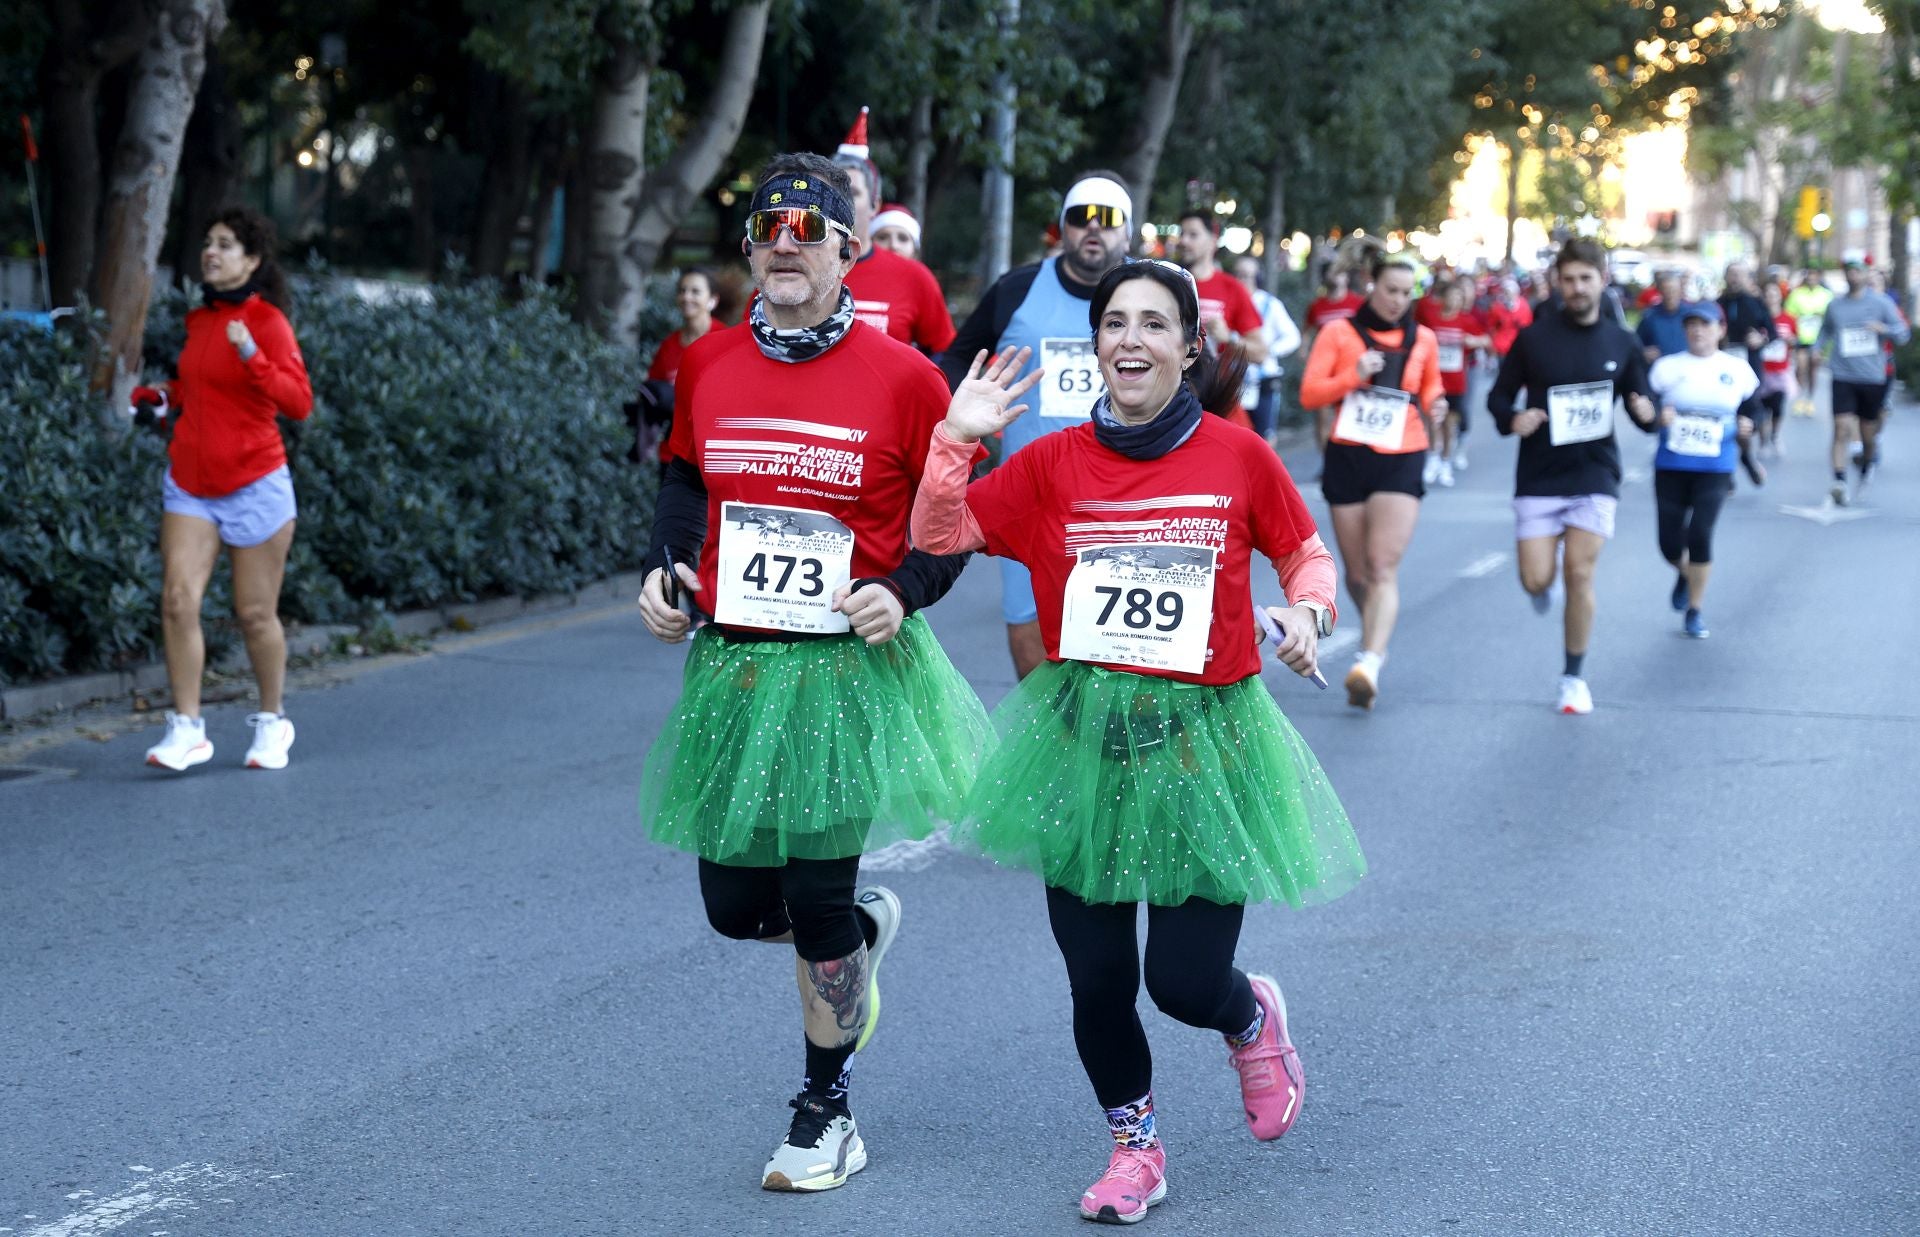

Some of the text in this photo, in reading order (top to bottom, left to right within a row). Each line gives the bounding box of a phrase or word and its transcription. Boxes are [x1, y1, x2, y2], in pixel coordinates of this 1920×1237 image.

[1355, 406, 1393, 429] 169
[1565, 404, 1602, 427] 796
[846, 429, 867, 442] XIV
[795, 444, 864, 466] CARRERA
[773, 453, 864, 475] SAN SILVESTRE
[739, 461, 862, 487] PALMA PALMILLA
[802, 488, 824, 497] CIUDAD
[824, 492, 860, 501] SALUDABLE
[1212, 494, 1233, 509] XIV
[1160, 518, 1228, 532] CARRERA
[803, 530, 851, 542] XIV
[1137, 529, 1227, 542] SAN SILVESTRE
[743, 552, 824, 597] 473
[1158, 570, 1206, 578] CARRERA
[1169, 562, 1211, 574] XIV
[1151, 578, 1206, 587] PALMILLA
[1155, 574, 1206, 582] SILVESTRE
[1095, 585, 1184, 632] 789
